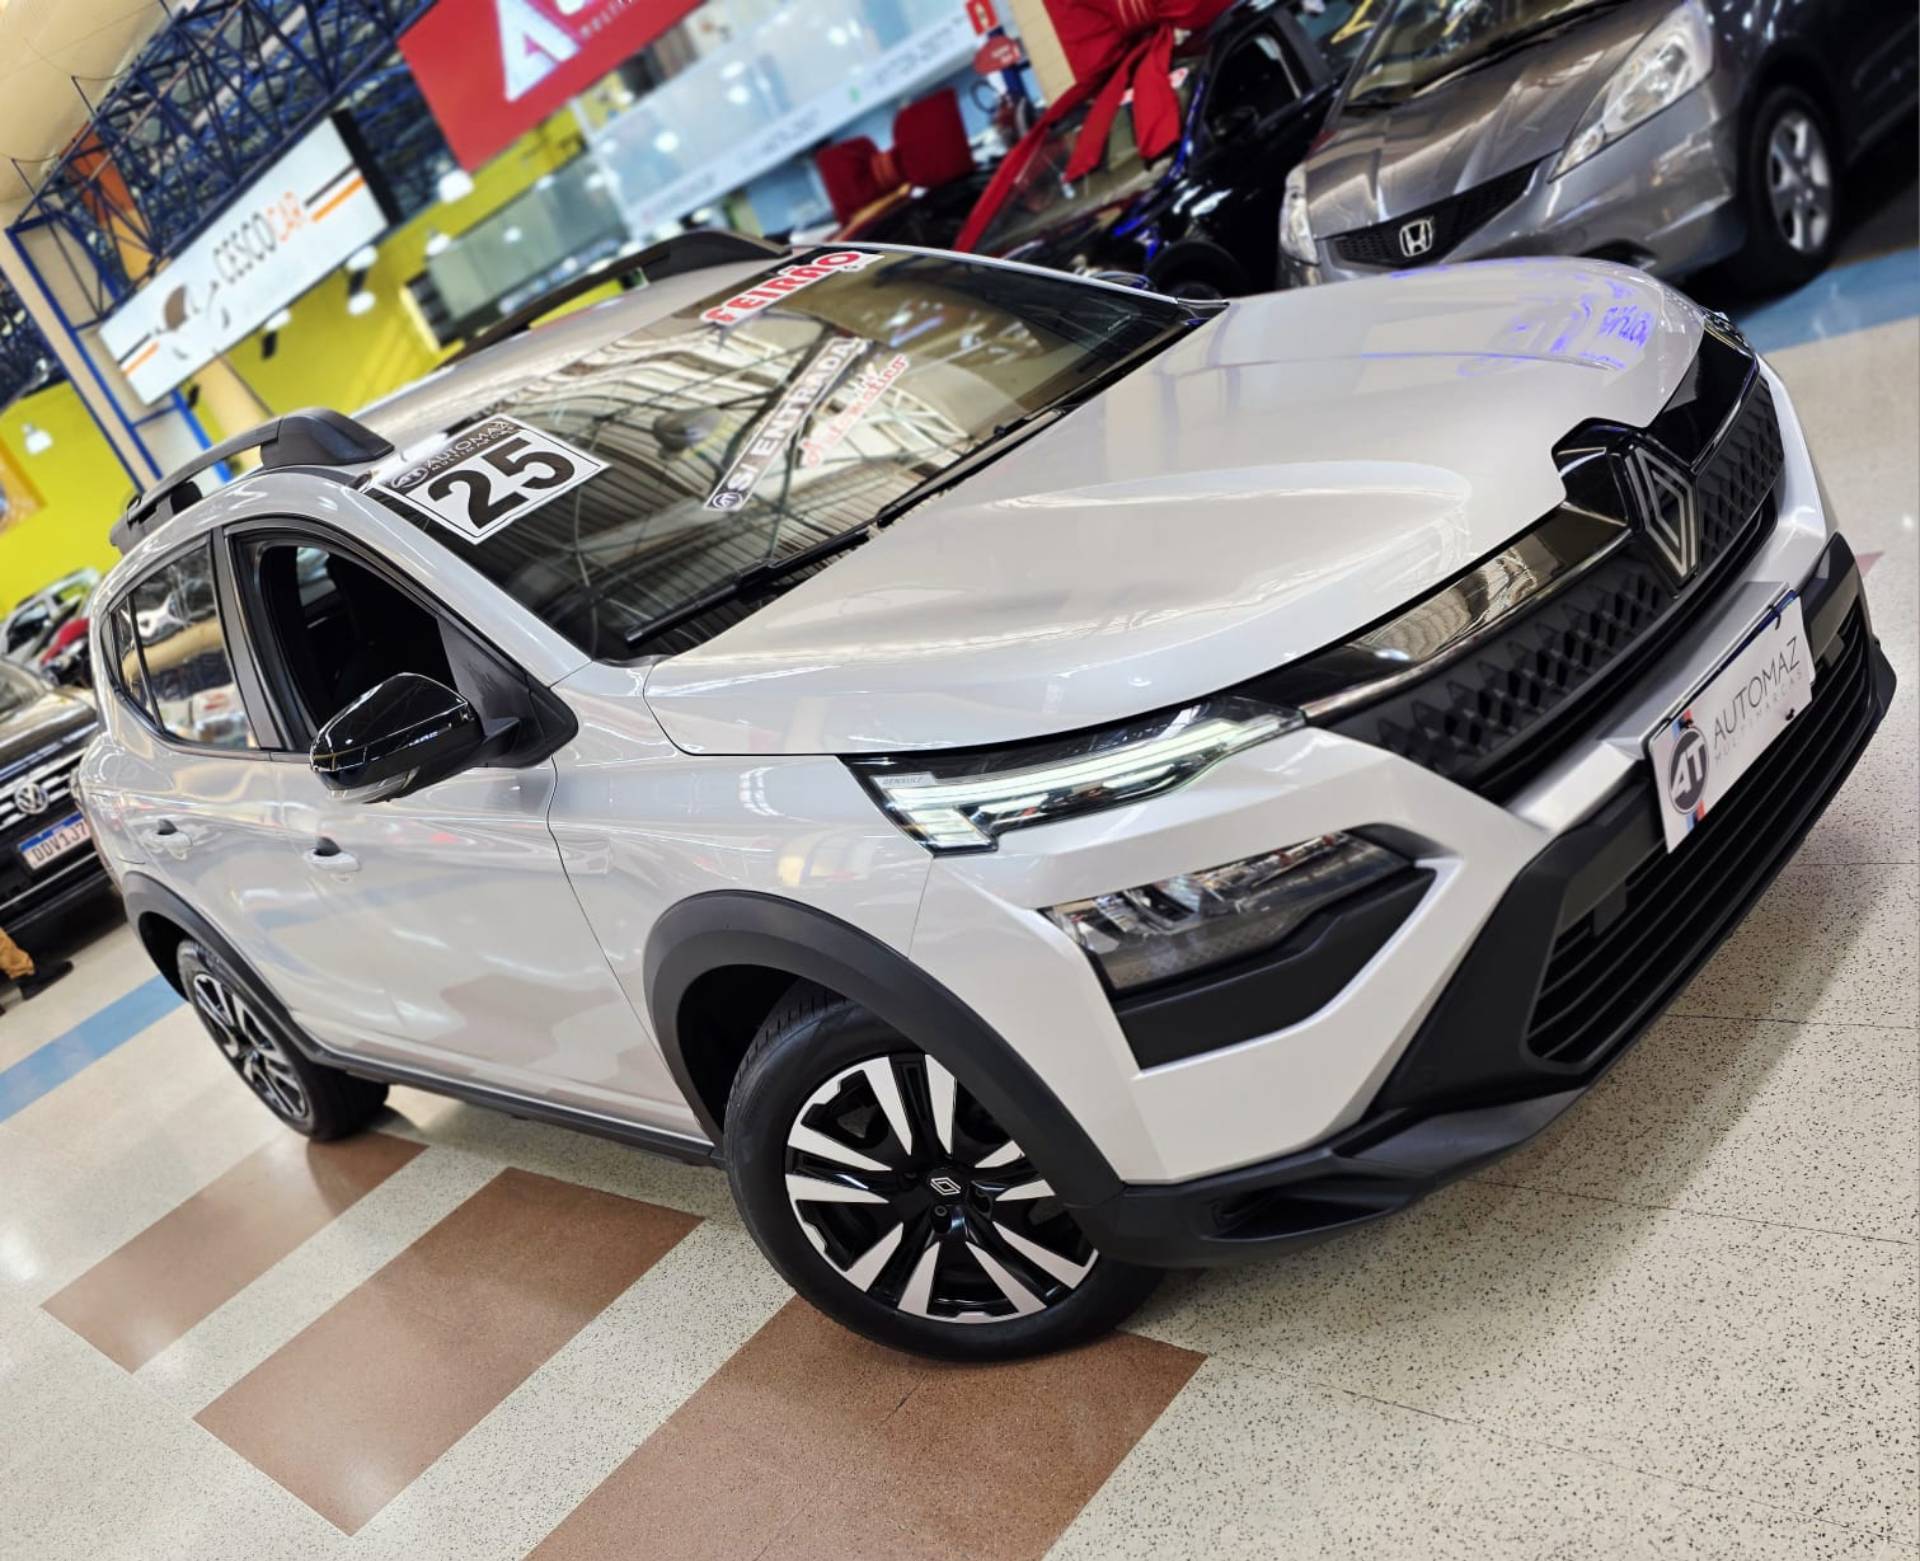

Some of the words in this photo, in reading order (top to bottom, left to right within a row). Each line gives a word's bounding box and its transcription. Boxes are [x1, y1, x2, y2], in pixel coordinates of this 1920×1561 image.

[706, 251, 861, 323] FEIRÃO
[425, 420, 513, 468] AUTOMAZ
[750, 339, 856, 458] ENTRADA
[428, 437, 575, 529] 25
[1713, 635, 1800, 749] AUTOMAZ
